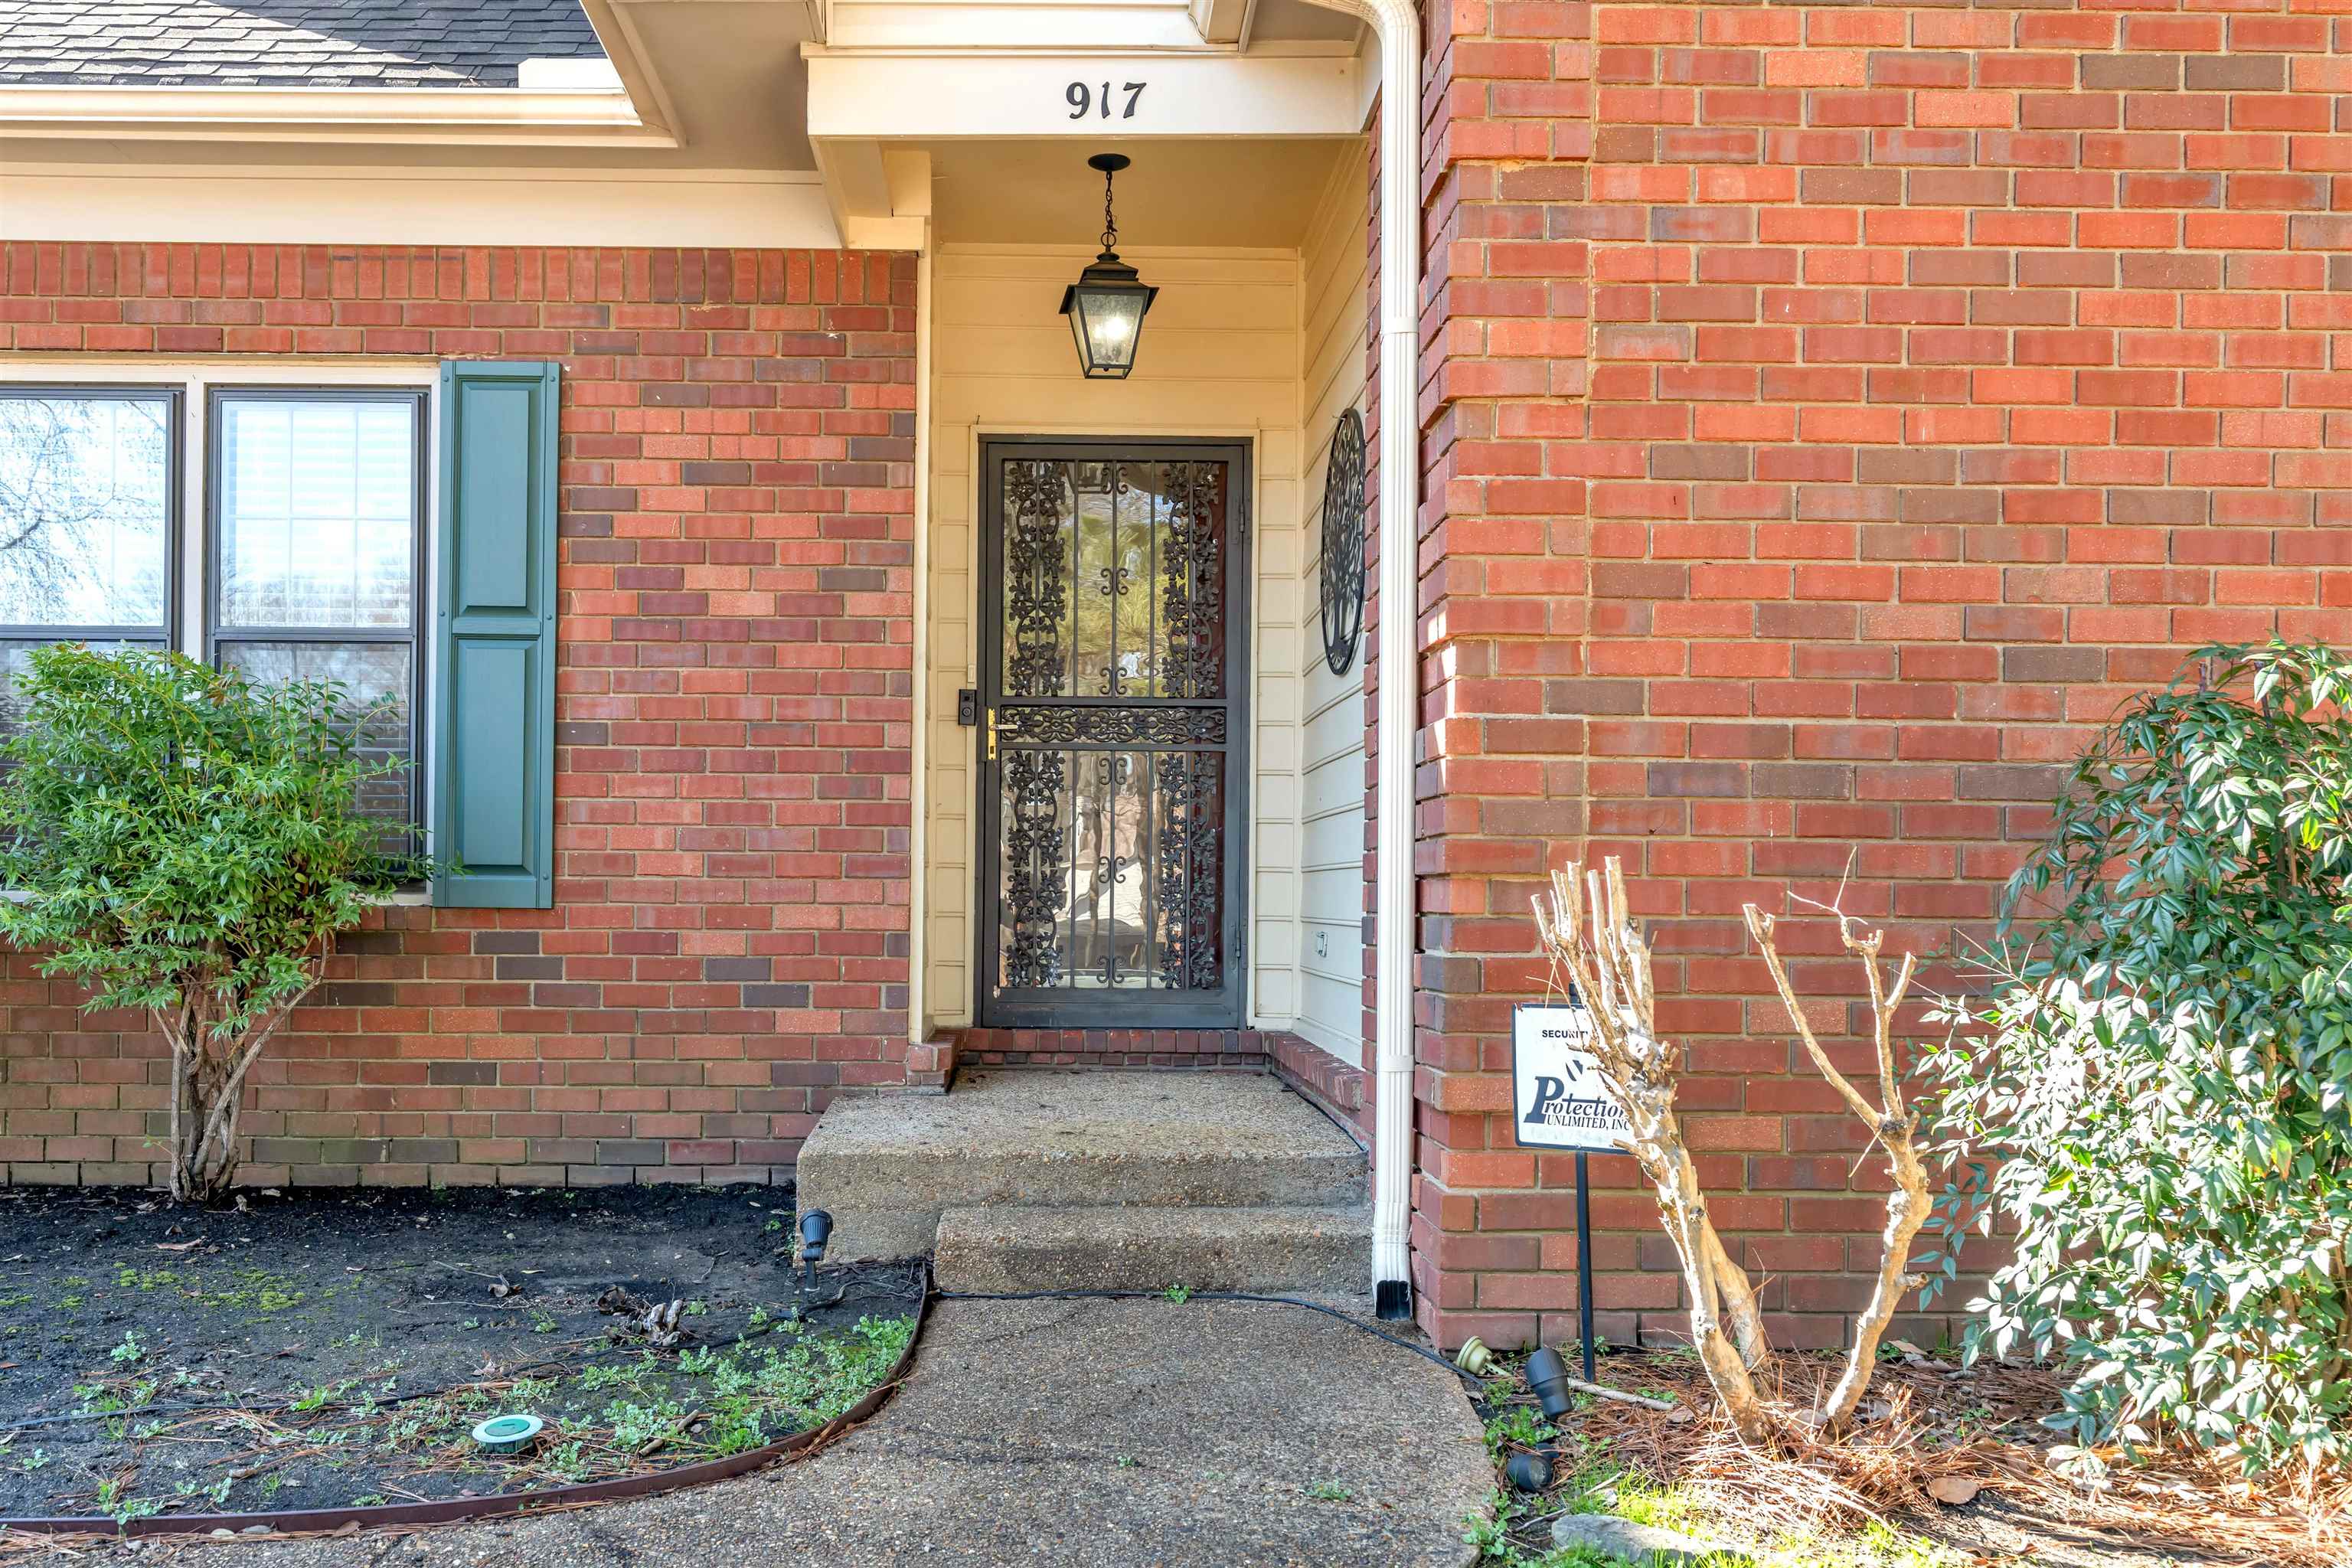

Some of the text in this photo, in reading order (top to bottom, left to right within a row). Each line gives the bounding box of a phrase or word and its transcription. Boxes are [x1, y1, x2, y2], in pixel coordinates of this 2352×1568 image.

[1066, 81, 1147, 119] 917
[1542, 1030, 1589, 1039] SECURIT
[1547, 1115, 1609, 1131] UNLIMITED,
